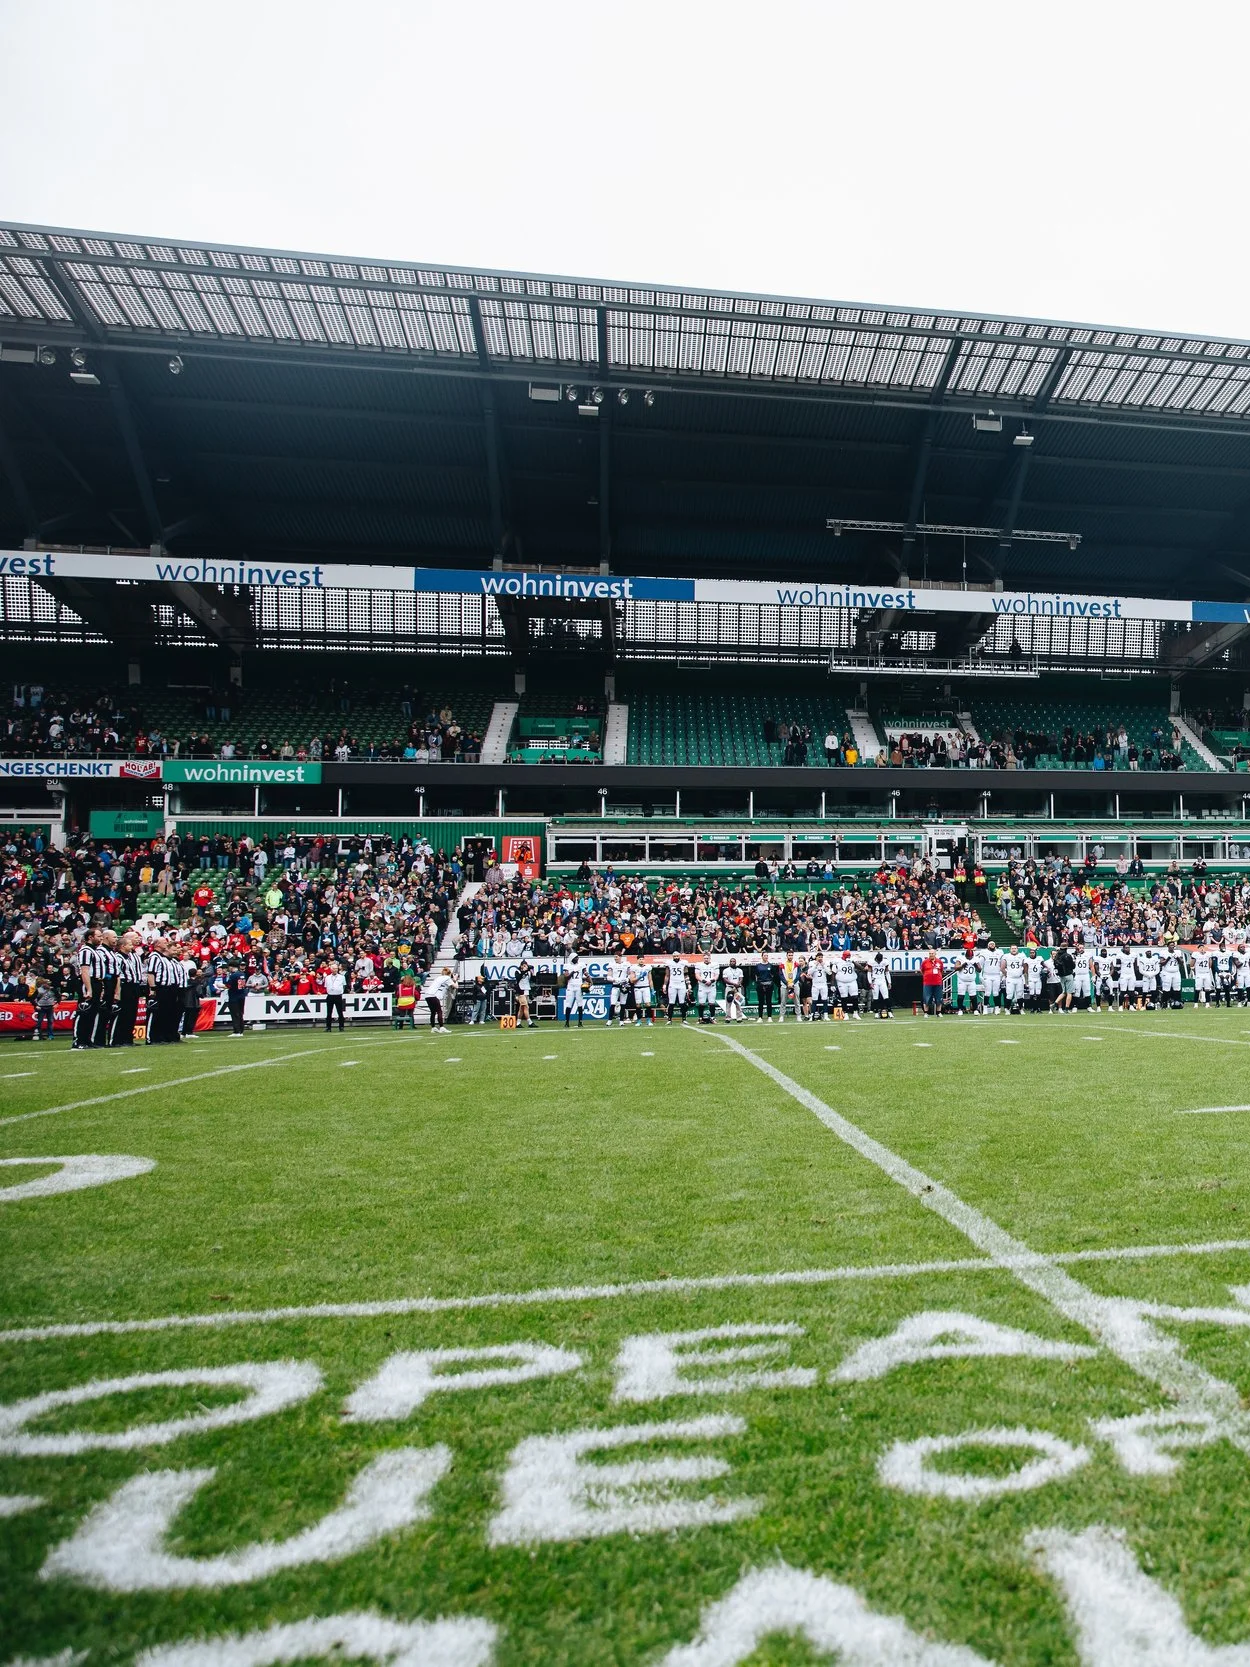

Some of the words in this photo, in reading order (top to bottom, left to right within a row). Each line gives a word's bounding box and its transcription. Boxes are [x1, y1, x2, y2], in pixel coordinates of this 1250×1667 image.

[155, 560, 324, 587] wohninvest
[480, 573, 633, 599] wohninvest
[777, 585, 916, 609] wohninvest
[992, 594, 1122, 618] wohninvest
[884, 717, 951, 728] wohninvest
[184, 764, 305, 783] wohninvest
[162, 783, 173, 791] 48
[414, 786, 425, 794] 48
[597, 787, 608, 795] 46
[891, 789, 901, 797] 46
[988, 958, 999, 967] 77
[1010, 961, 1020, 970] 63
[1077, 960, 1087, 969] 65
[1198, 960, 1208, 968] 42
[618, 970, 624, 978] 7
[672, 967, 682, 976] 35
[703, 971, 713, 979] 91
[817, 970, 823, 978] 3
[841, 966, 853, 975] 98
[963, 966, 975, 975] 50
[503, 1018, 513, 1028] 30
